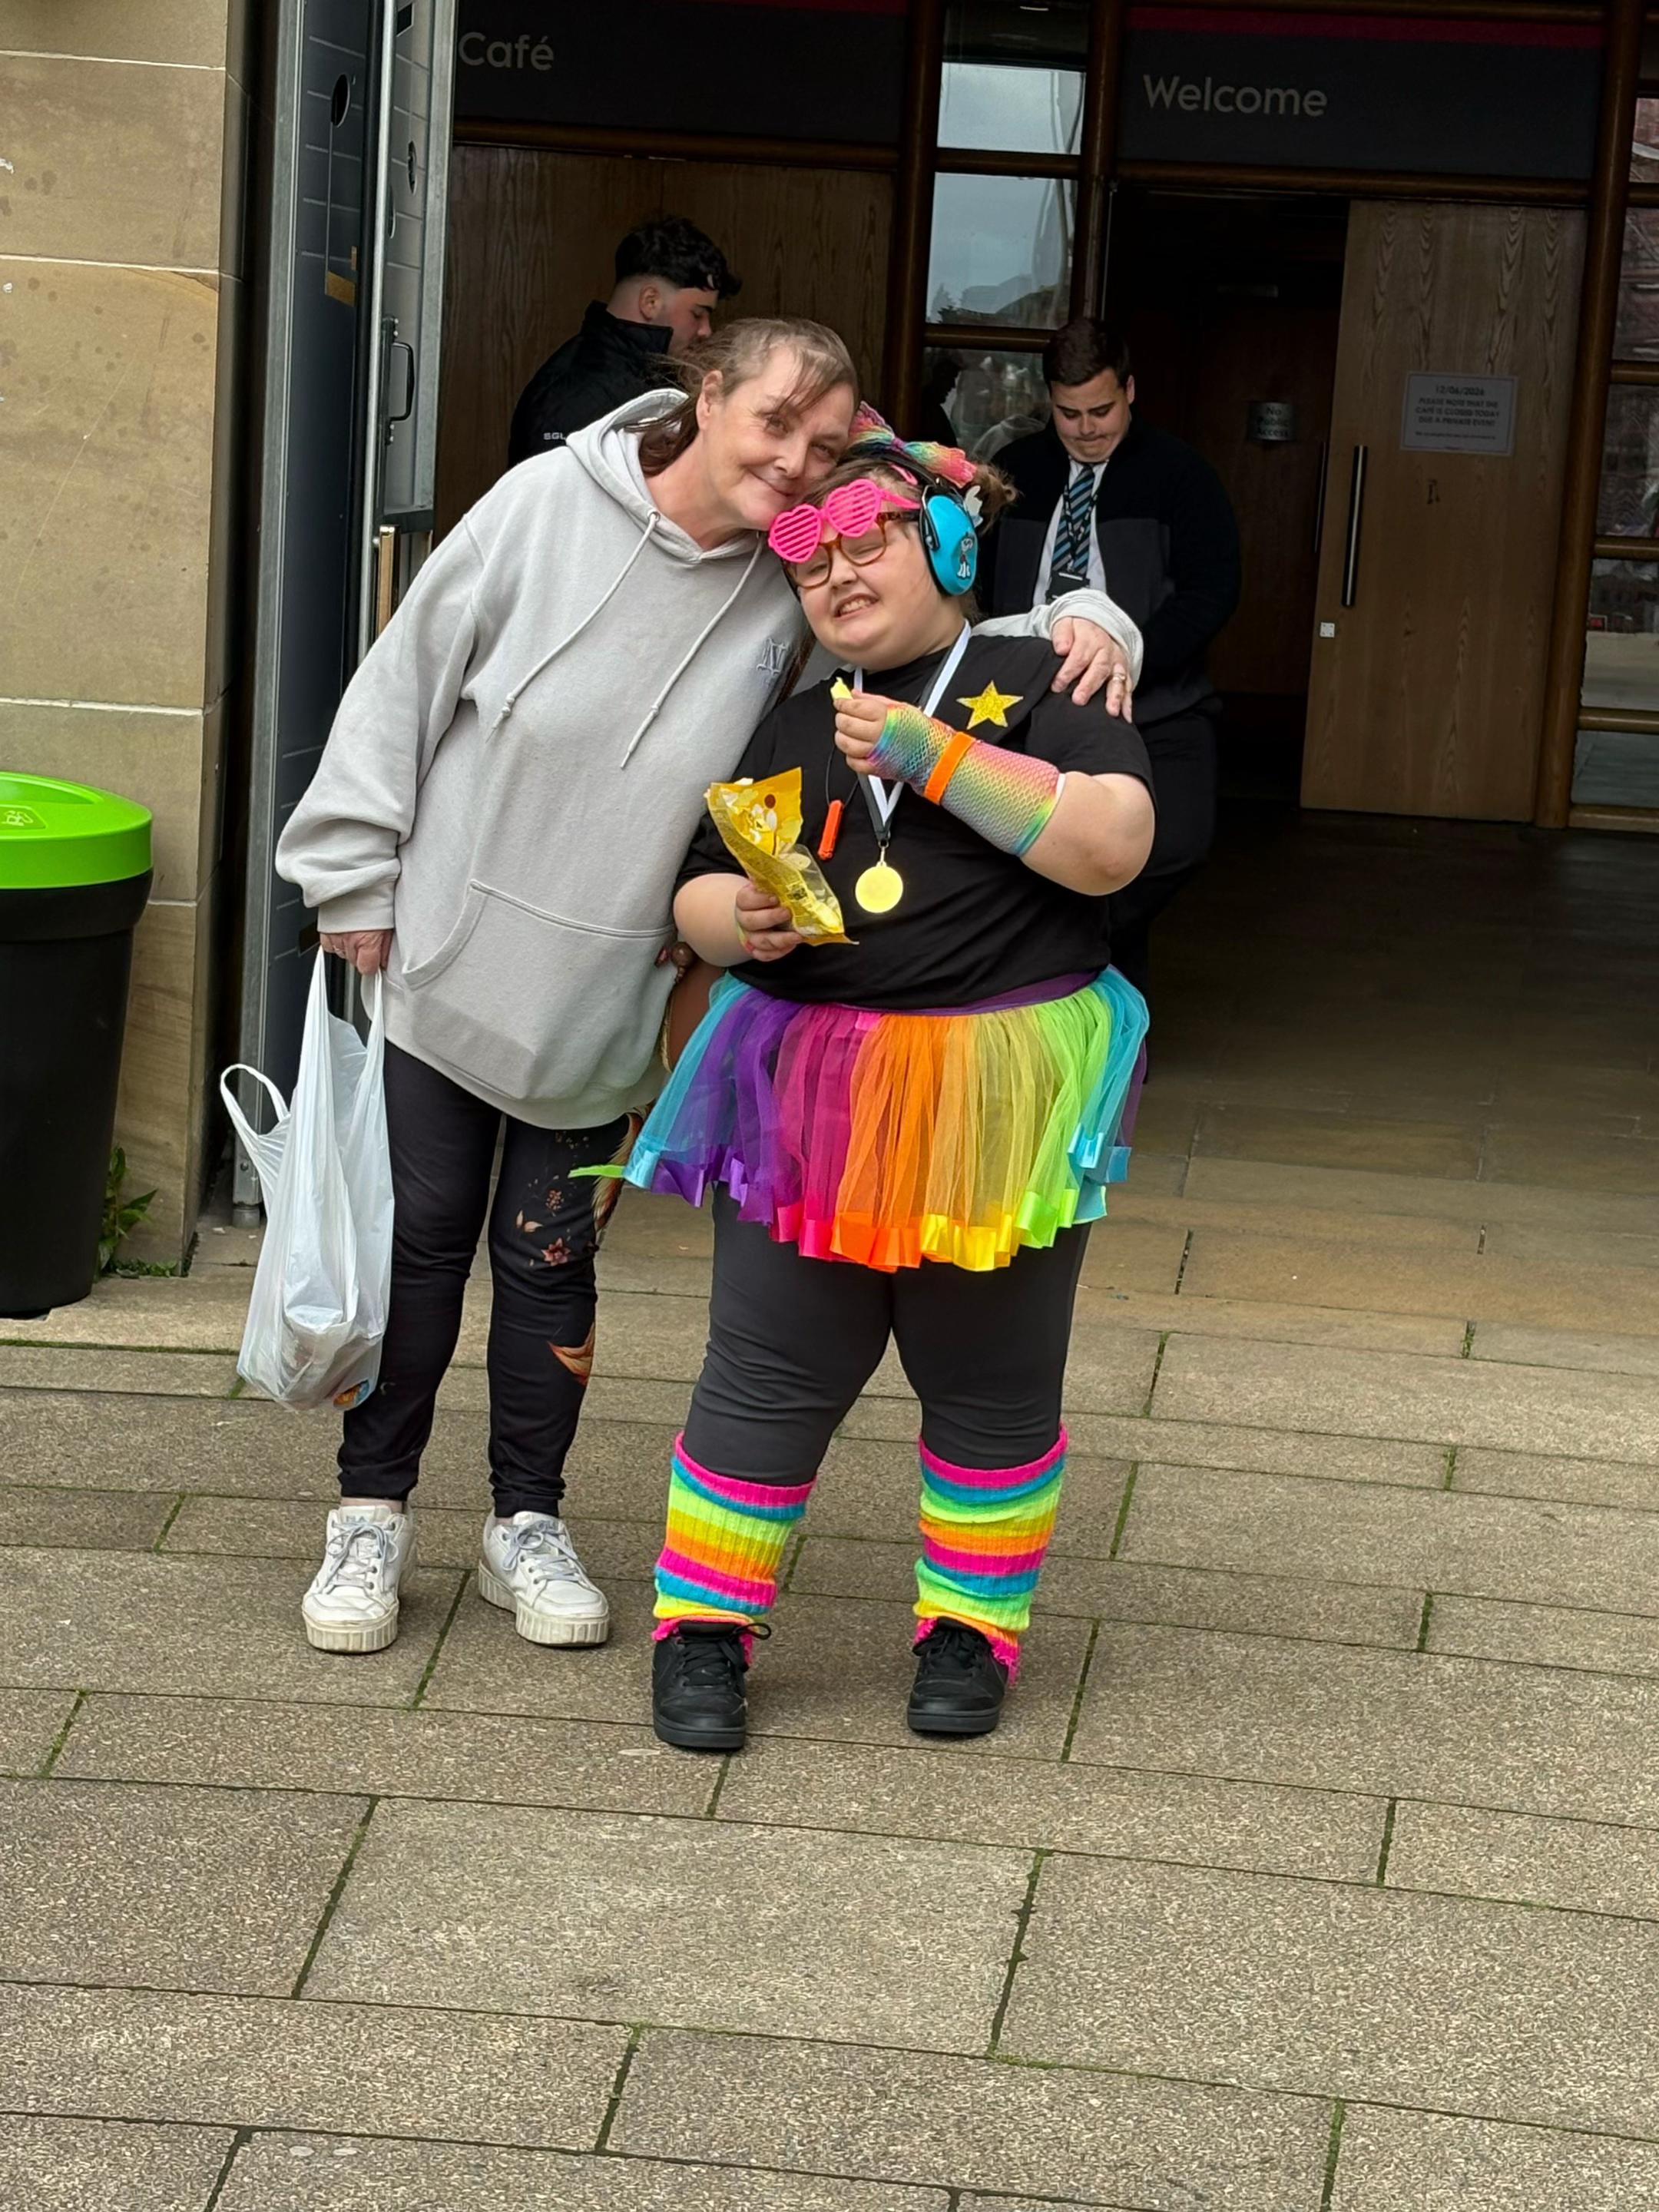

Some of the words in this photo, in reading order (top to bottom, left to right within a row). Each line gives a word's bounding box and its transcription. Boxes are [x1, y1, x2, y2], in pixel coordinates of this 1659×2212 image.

[459, 31, 554, 71] Café
[1143, 74, 1328, 117] Welcome
[1266, 406, 1282, 416] No
[1475, 409, 1499, 418] TODAY
[1257, 416, 1290, 427] Public
